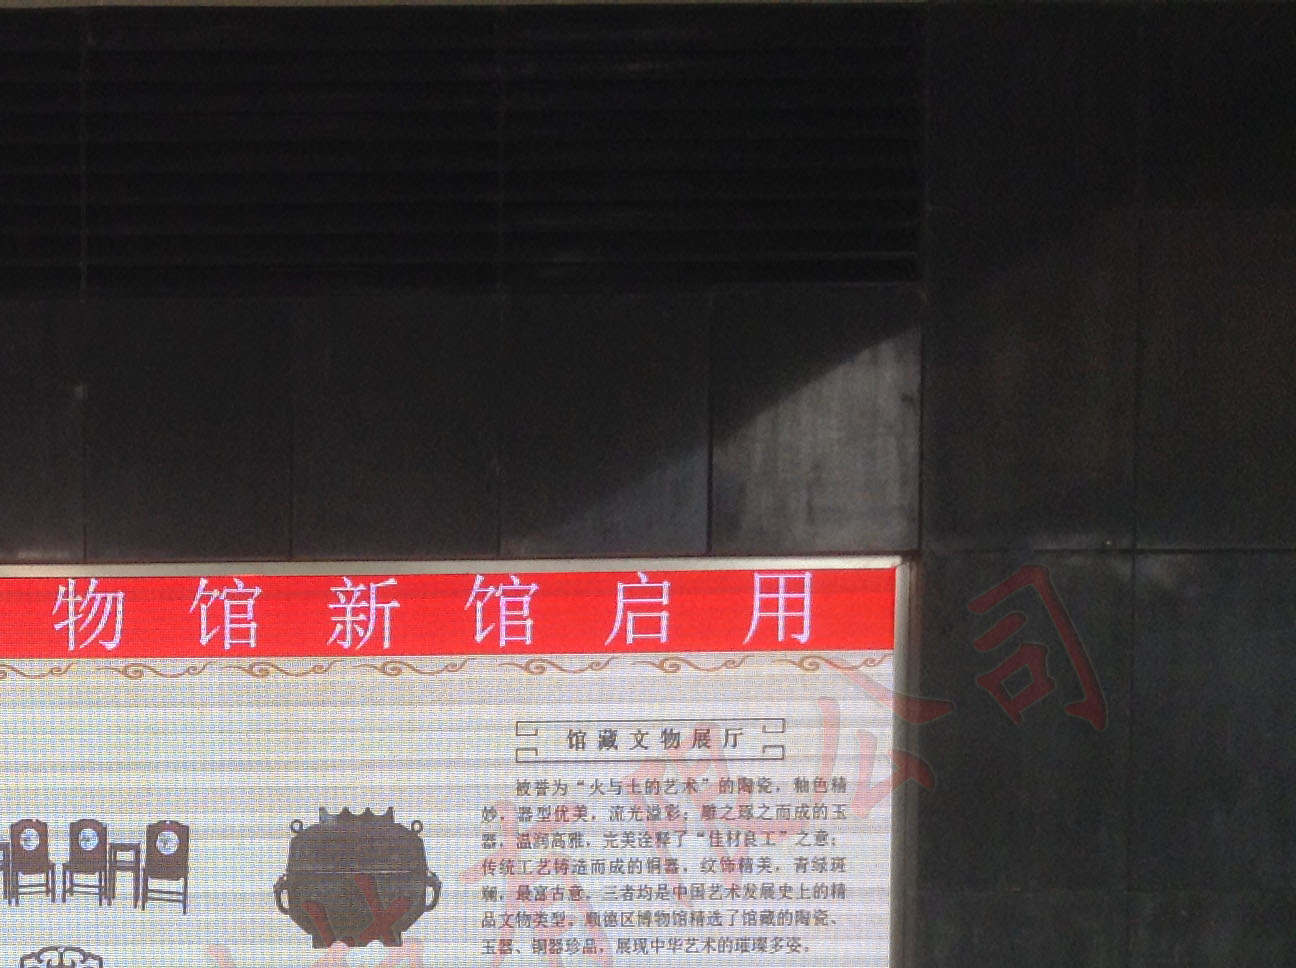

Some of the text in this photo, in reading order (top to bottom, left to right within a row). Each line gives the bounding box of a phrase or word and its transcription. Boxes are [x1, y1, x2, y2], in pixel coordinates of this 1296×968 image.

[567, 728, 745, 751] 馆藏文物展厅
